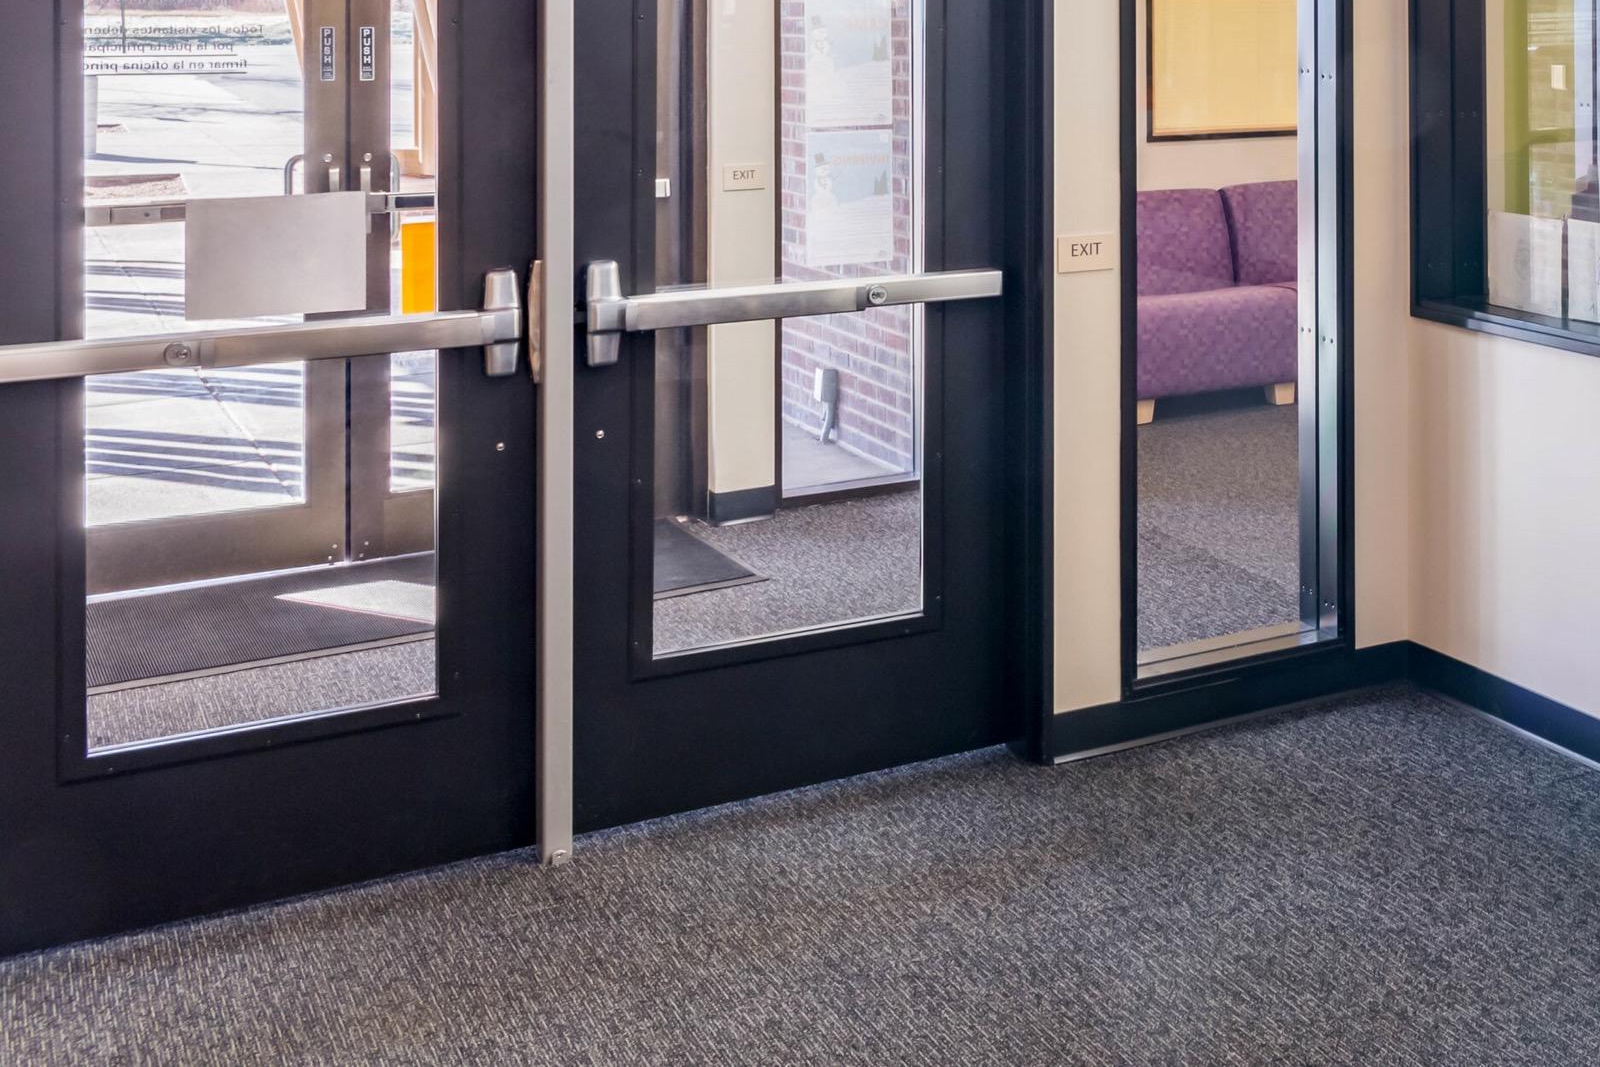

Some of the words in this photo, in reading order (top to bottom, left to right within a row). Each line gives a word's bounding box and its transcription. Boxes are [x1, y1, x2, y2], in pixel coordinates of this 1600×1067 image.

[363, 29, 371, 64] PUSH
[733, 169, 755, 180] EXIT
[1071, 241, 1102, 257] EXIT
